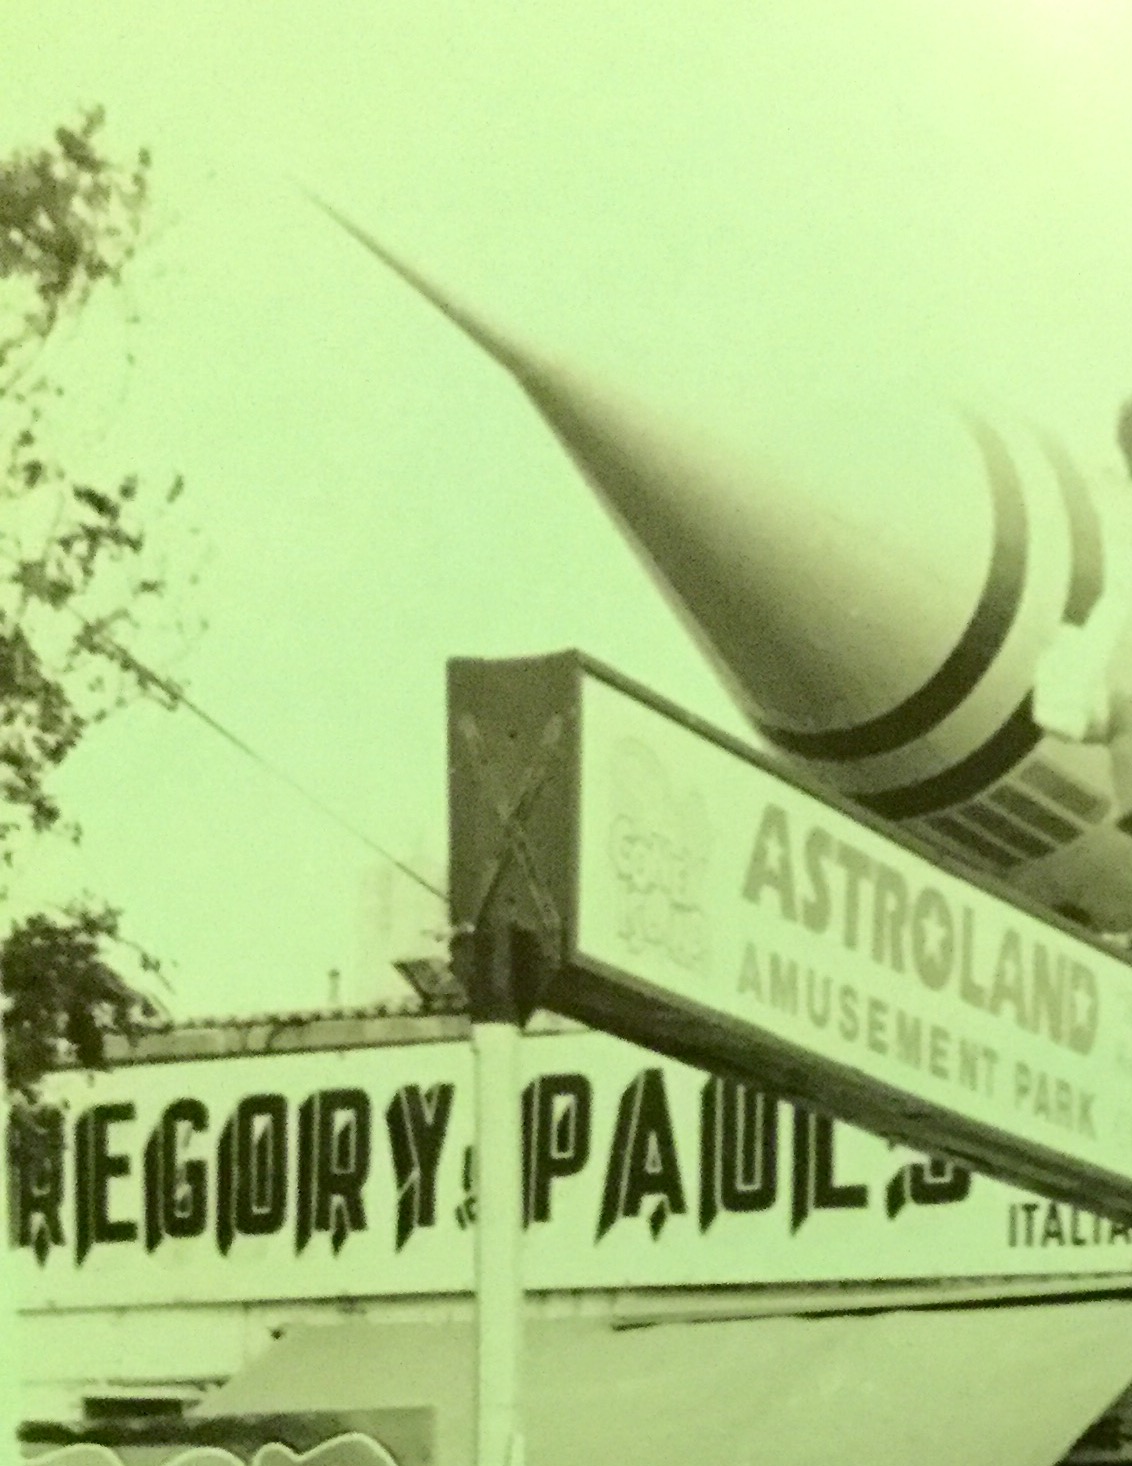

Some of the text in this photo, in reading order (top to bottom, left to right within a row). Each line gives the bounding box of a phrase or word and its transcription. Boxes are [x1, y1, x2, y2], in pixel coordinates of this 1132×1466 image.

[740, 803, 1100, 1057] ASTROLAND
[737, 941, 1000, 1097] AMUSEMENT
[1014, 1062, 1099, 1140] PARK
[521, 1064, 974, 1243] PAUL
